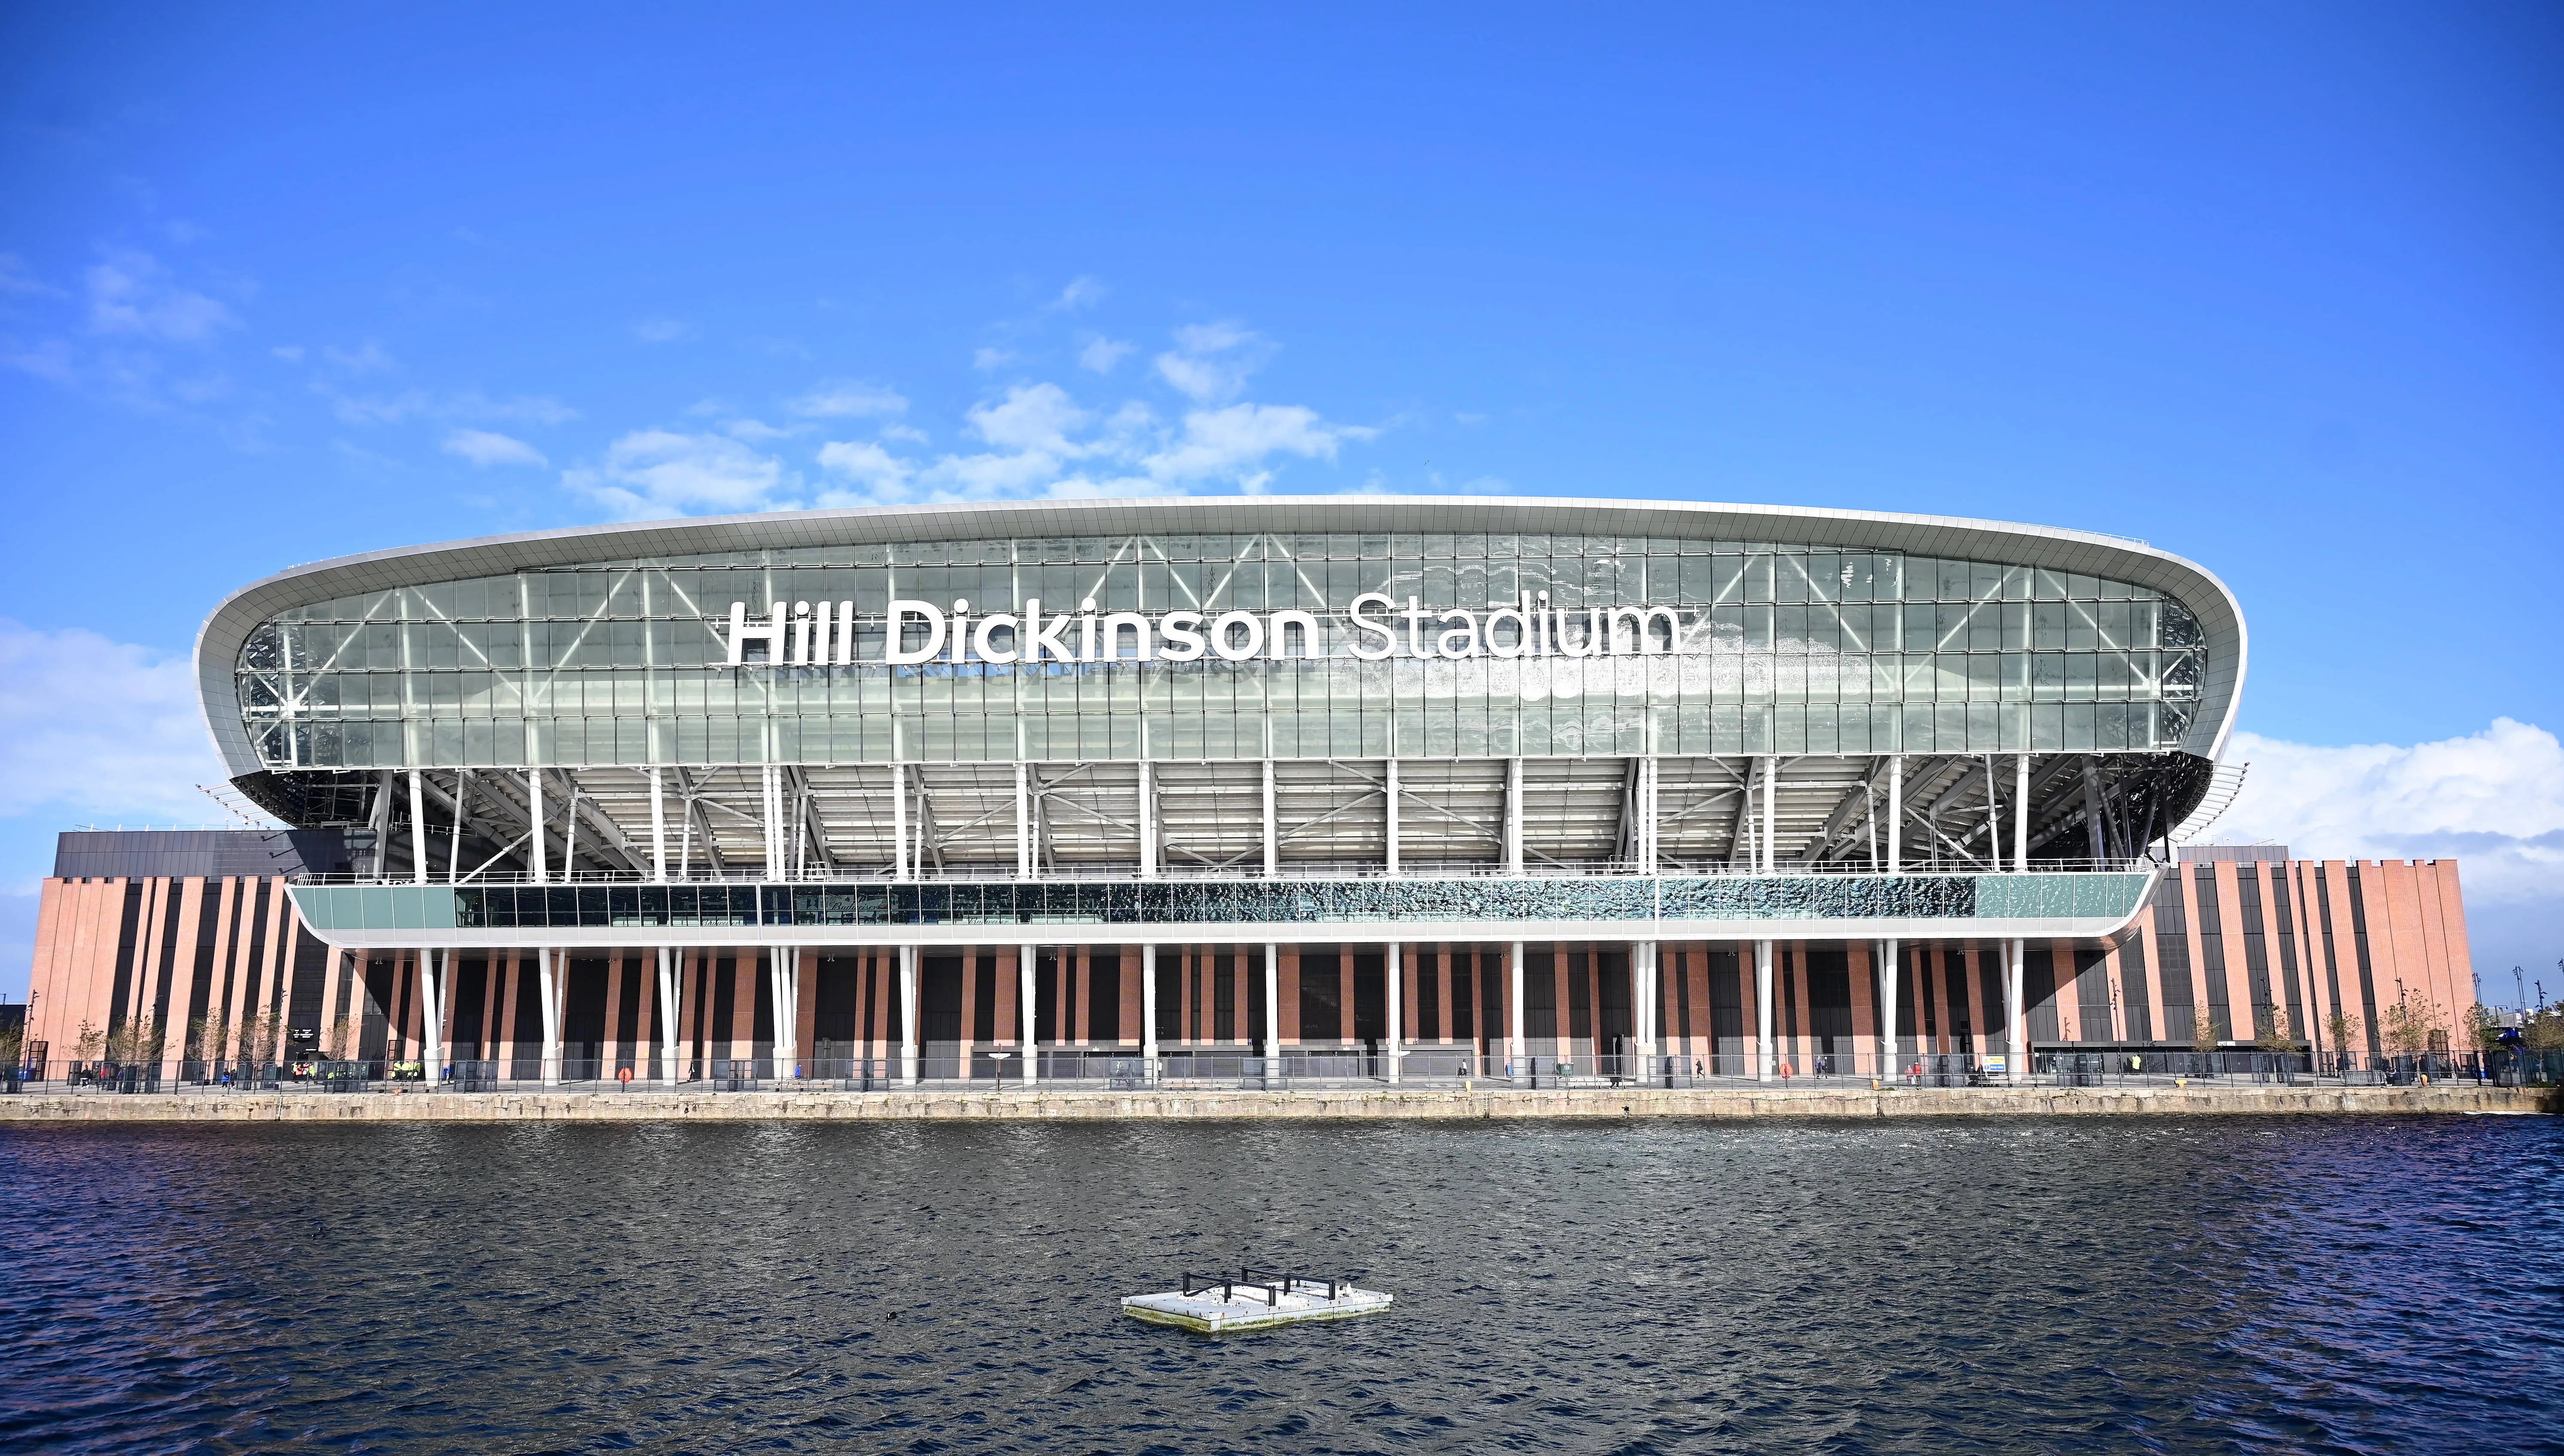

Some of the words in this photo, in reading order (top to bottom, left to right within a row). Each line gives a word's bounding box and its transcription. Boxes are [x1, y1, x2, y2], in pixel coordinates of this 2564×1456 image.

[728, 600, 853, 666] Hill
[885, 597, 1319, 665] Dickinson
[1347, 590, 1680, 660] Stadium
